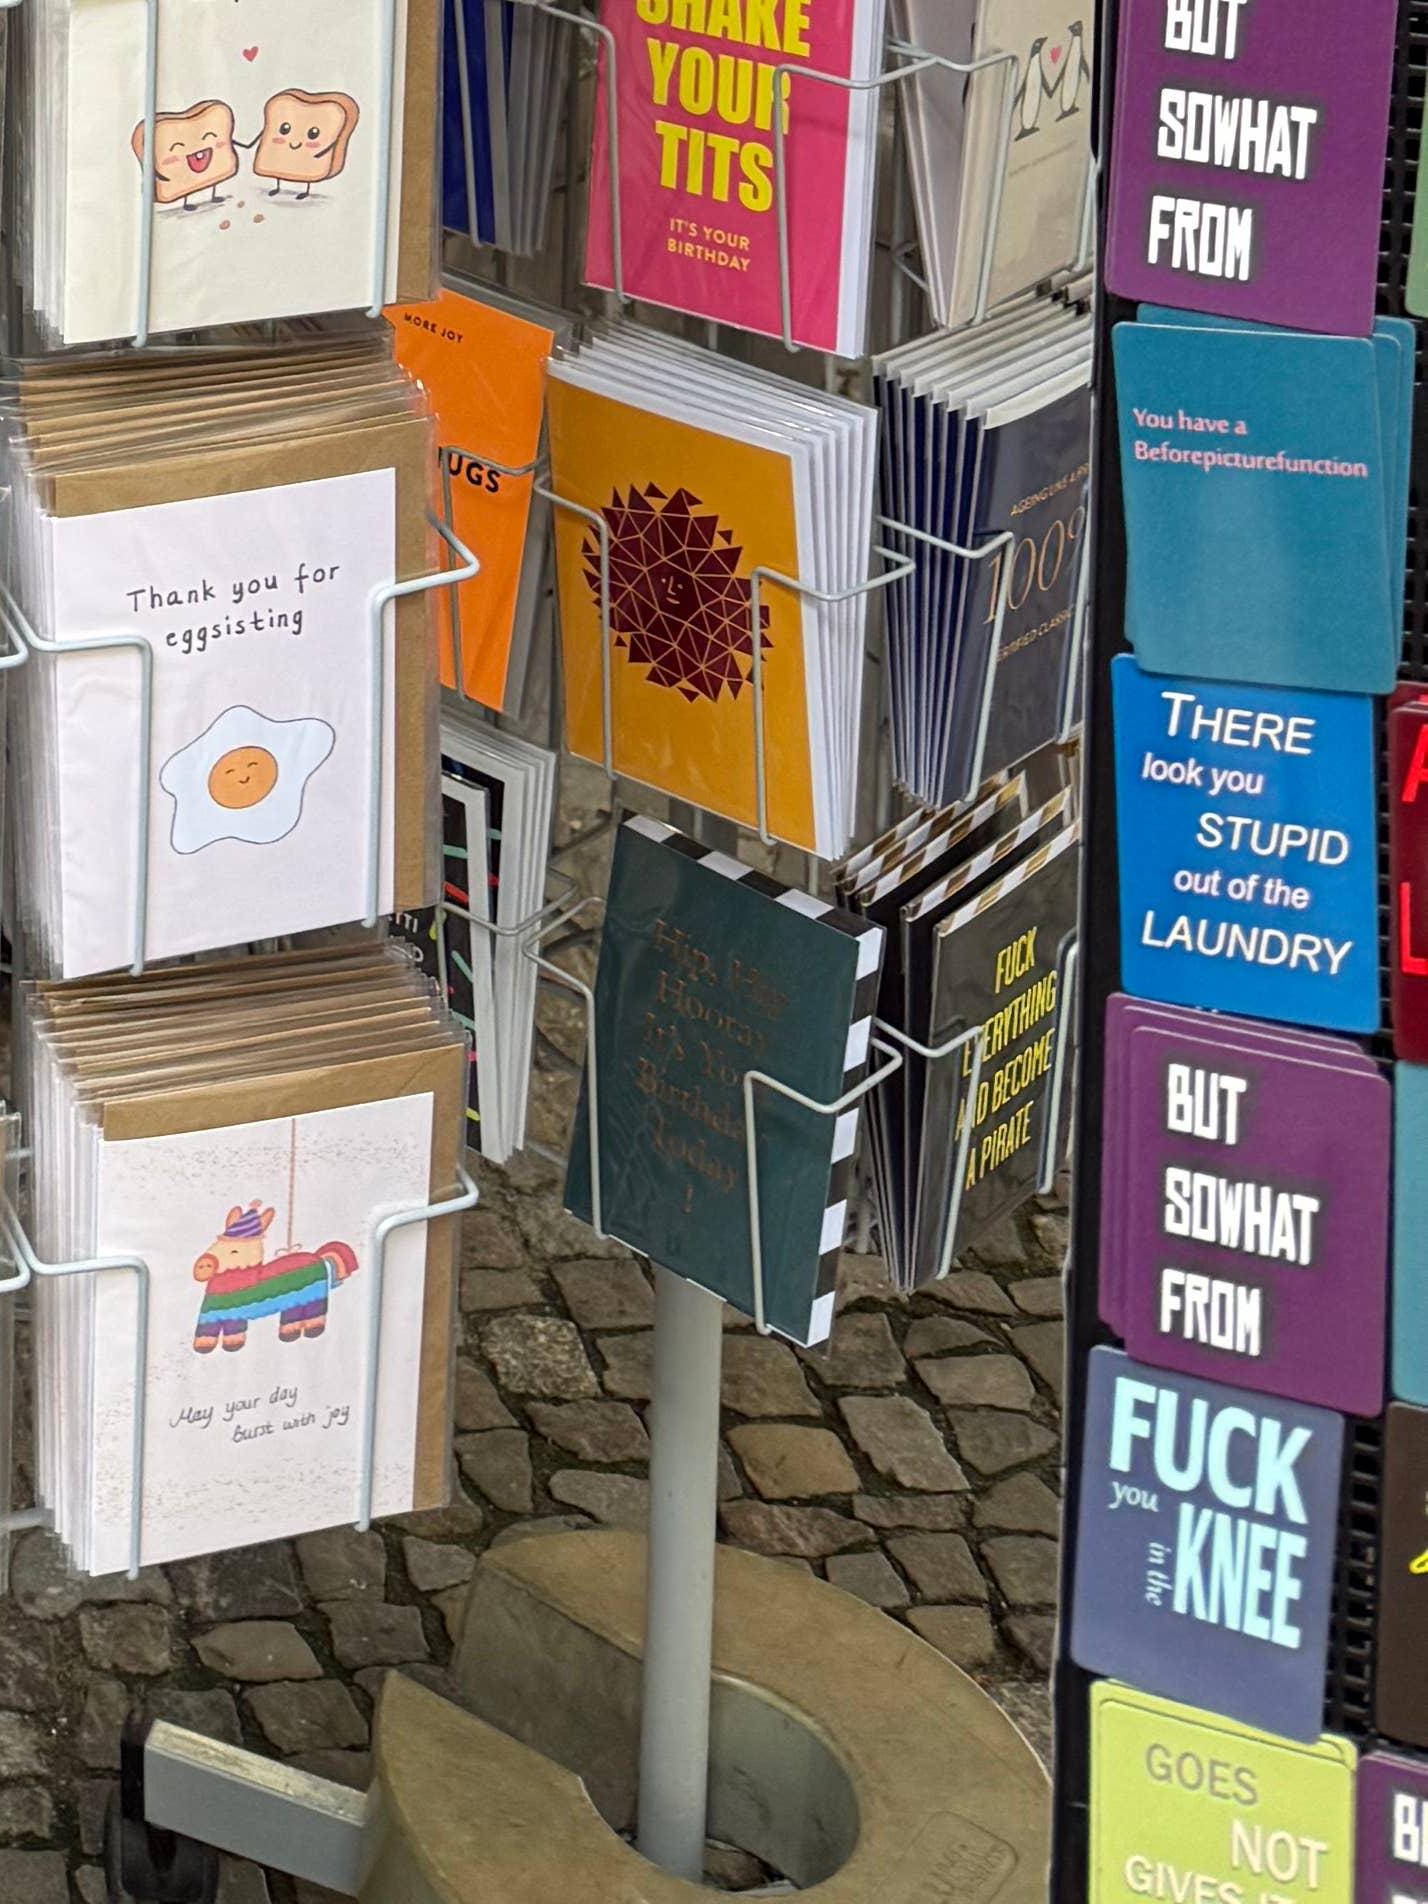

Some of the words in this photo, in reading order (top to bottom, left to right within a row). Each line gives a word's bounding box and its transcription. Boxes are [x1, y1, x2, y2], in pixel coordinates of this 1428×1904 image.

[647, 38, 790, 136] YOUR
[1157, 88, 1317, 180] SOWHAT
[655, 121, 774, 213] TITS
[667, 238, 752, 272] BIRTHDAY
[669, 216, 698, 238] IT'S
[704, 225, 750, 252] YOUR
[1148, 195, 1252, 281] FROM
[404, 312, 437, 332] MORE
[441, 329, 464, 343] JOY
[1133, 408, 1173, 429] You
[1178, 410, 1229, 434] have
[1235, 420, 1247, 435] a
[1134, 440, 1368, 479] Beforepicturefunction
[127, 584, 215, 613] Thank
[231, 572, 279, 606] you
[294, 561, 341, 589] for
[165, 605, 304, 654] eggsisting
[1161, 691, 1316, 755] THERE
[1142, 752, 1203, 787] look
[1209, 767, 1264, 795] you
[1196, 813, 1349, 865] STUPID
[1174, 869, 1221, 896] out
[1227, 874, 1260, 901] of
[1263, 879, 1310, 909] the
[995, 926, 1037, 994] FUCK
[1142, 910, 1352, 975] LAUNDRY
[992, 1027, 1055, 1114] BECOME
[980, 1100, 1034, 1179] PIRATE
[1109, 1376, 1313, 1525] FUCK
[1108, 1480, 1159, 1513] you
[1147, 1542, 1170, 1565] in
[1173, 1502, 1308, 1649] KNEE
[1145, 1567, 1172, 1606] the
[1145, 1743, 1258, 1806] GOES
[1232, 1819, 1328, 1889] NOT
